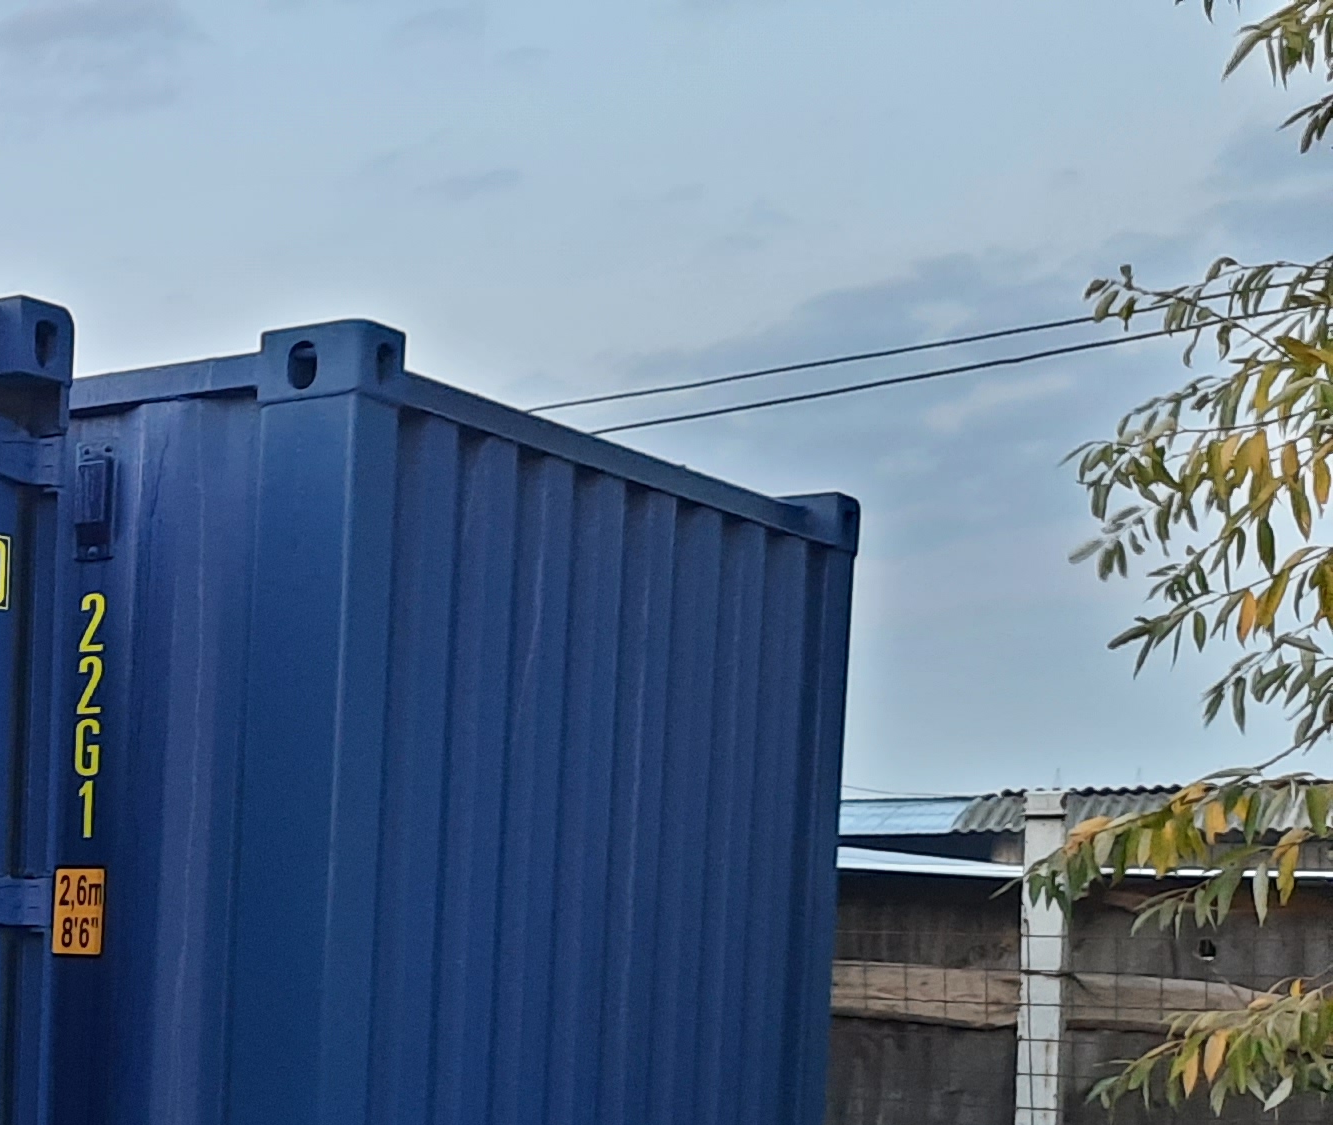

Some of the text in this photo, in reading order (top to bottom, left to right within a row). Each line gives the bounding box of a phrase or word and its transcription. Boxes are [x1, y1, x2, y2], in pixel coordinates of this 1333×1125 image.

[75, 592, 107, 838] 22G1
[58, 874, 103, 912] 2,6m
[61, 916, 99, 949] 8'6"
